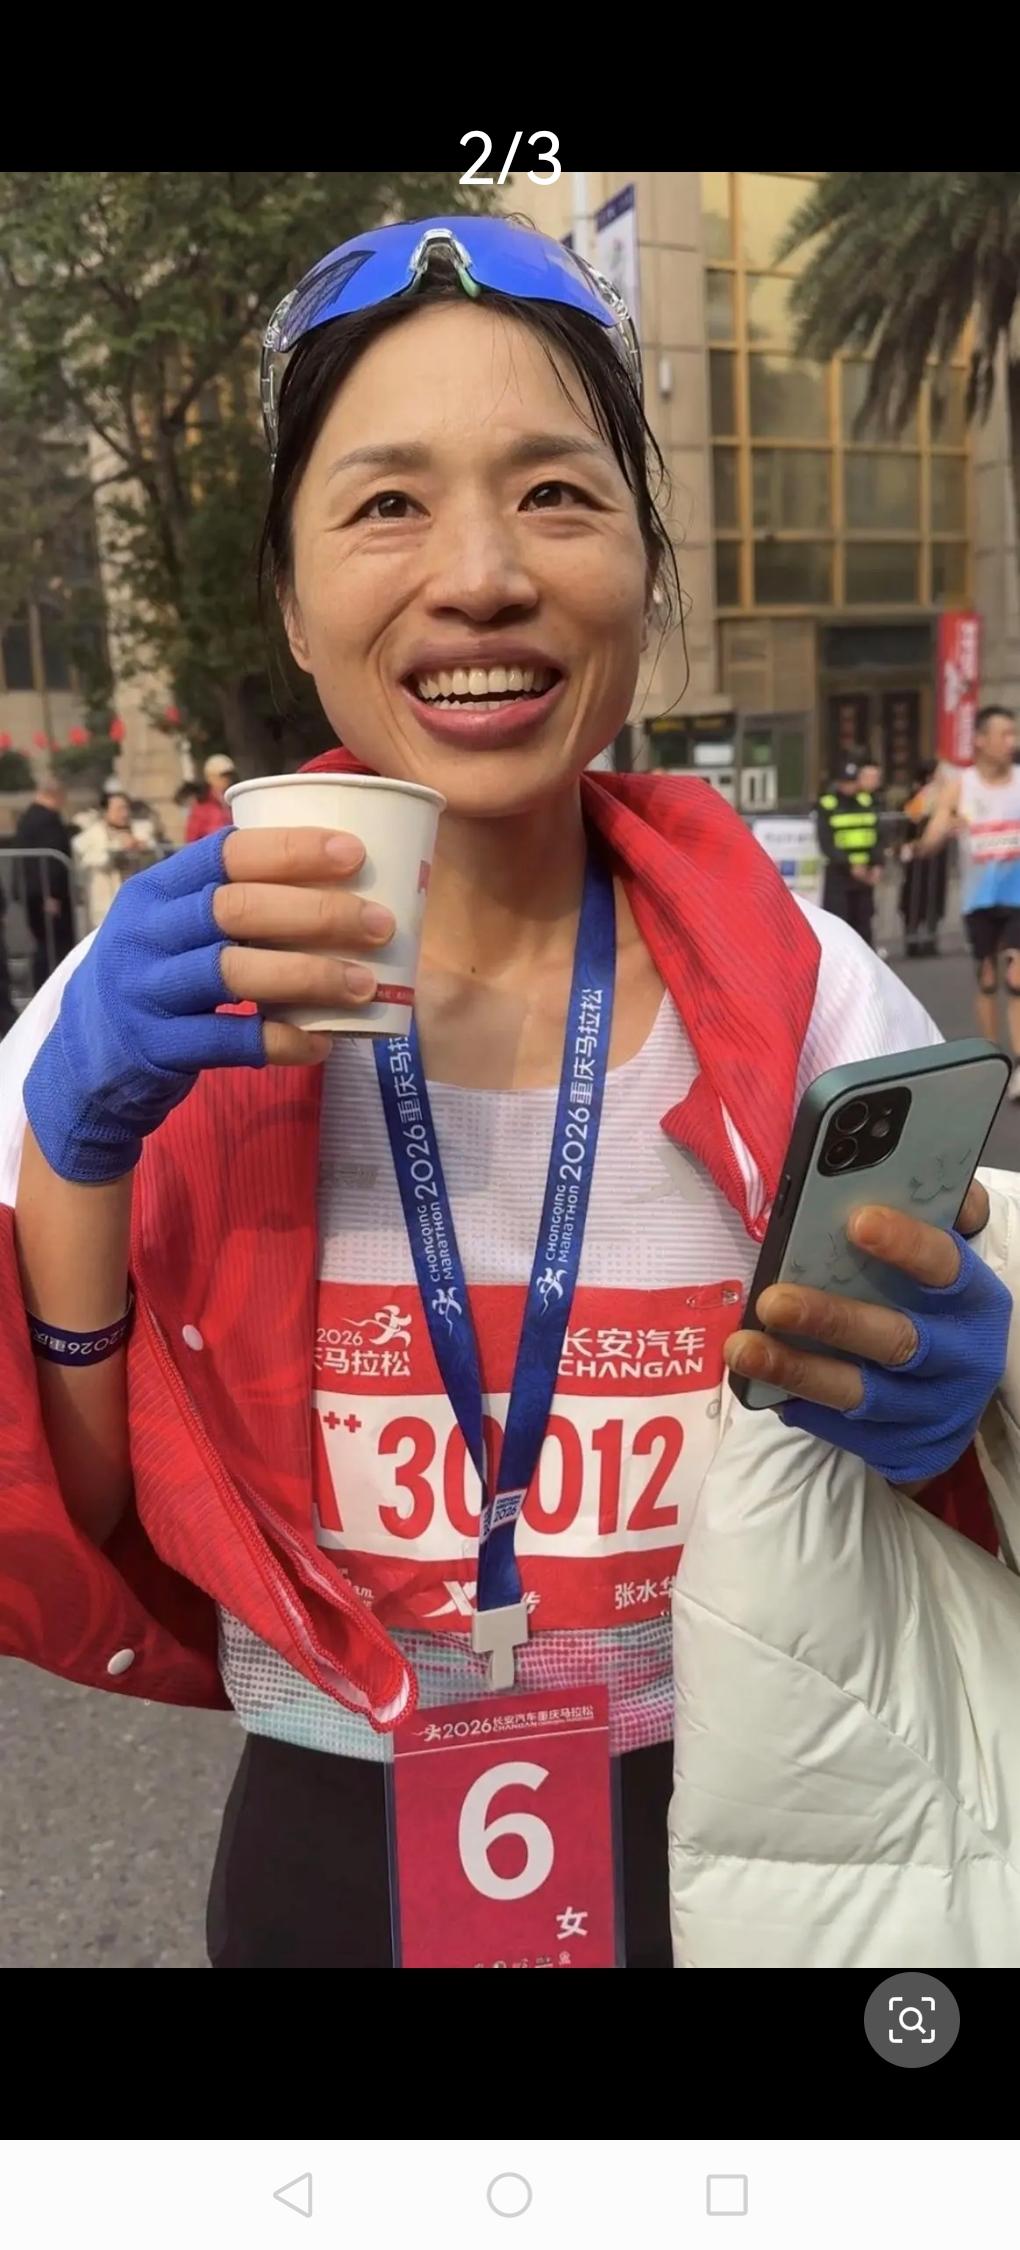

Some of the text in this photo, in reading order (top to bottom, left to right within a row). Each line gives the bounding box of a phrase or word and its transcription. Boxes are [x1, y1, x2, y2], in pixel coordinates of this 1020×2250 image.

[558, 987, 604, 1183] 2026重庆马拉松
[317, 1328, 364, 1346] 2026
[562, 1326, 706, 1359] 长安汽车
[557, 1357, 703, 1379] CHANGAN
[377, 1414, 685, 1541] 30012
[442, 1718, 491, 1740] 2026
[457, 1760, 556, 1902] 6
[556, 1906, 588, 1940] 女
